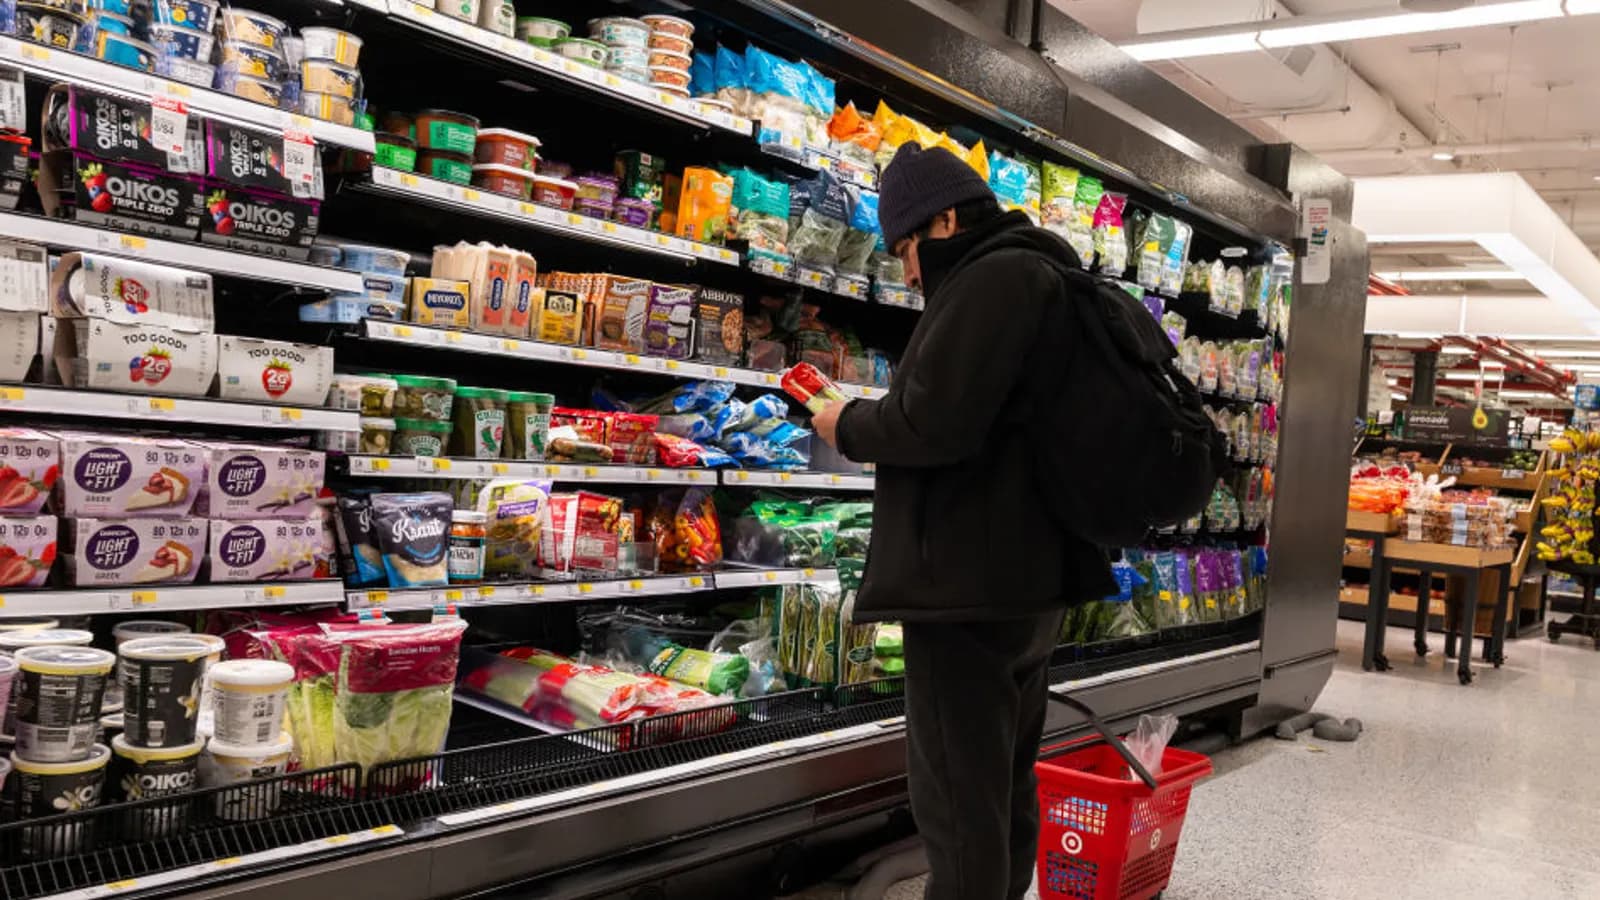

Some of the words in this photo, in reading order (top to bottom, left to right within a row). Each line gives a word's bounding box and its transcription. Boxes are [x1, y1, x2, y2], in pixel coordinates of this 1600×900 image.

[96, 98, 112, 149] OIKOS
[230, 129, 244, 177] OIKOS
[106, 176, 179, 207] OIKOS
[111, 197, 145, 210] TRIPLE
[147, 203, 174, 215] ZERO
[229, 202, 295, 229] OIKOS
[234, 221, 263, 233] TRIPLE
[265, 225, 290, 237] ZERO
[123, 333, 147, 344] TOO
[248, 348, 269, 358] TOO
[15, 445, 31, 457] 12g
[37, 447, 50, 457] 0g
[145, 451, 158, 462] 80
[164, 452, 179, 464] 12g
[84, 460, 128, 477] LIGHT
[227, 466, 263, 482] LIGHT
[13, 525, 29, 537] 12g
[34, 525, 47, 537] 0g
[153, 526, 165, 536] 80
[170, 526, 184, 537] 12g
[94, 536, 136, 555] LIGHT
[228, 536, 262, 553] LIGHT
[140, 768, 197, 790] OIKOS
